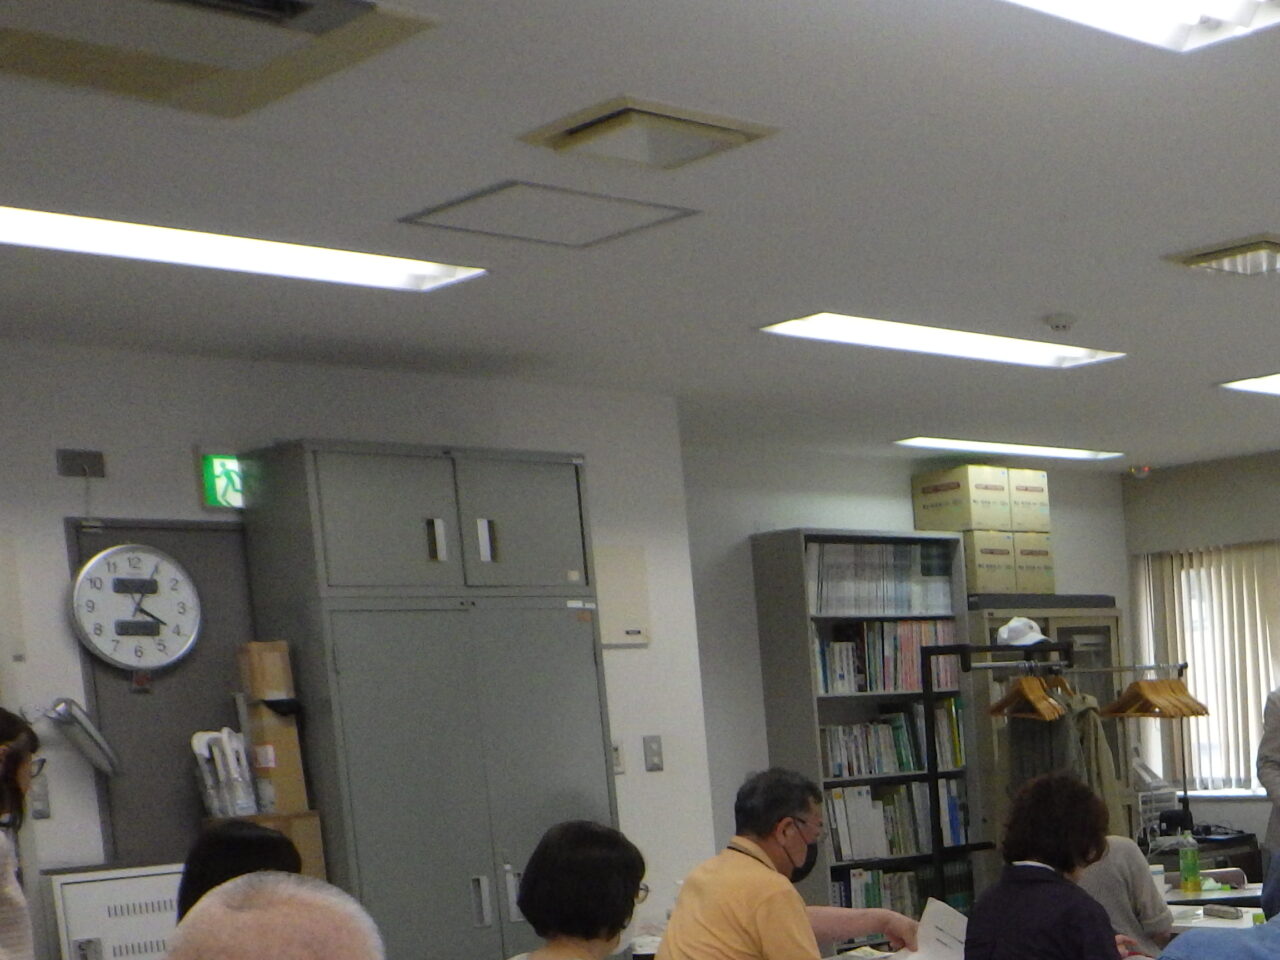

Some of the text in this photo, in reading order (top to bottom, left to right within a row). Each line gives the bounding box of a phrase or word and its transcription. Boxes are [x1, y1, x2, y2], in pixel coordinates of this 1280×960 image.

[106, 561, 118, 574] 11
[127, 556, 142, 569] 12
[88, 577, 103, 591] 10
[170, 578, 179, 592] 2
[86, 600, 95, 613] 9
[178, 601, 186, 615] 3
[93, 622, 103, 636] 8
[172, 624, 181, 637] 4
[111, 639, 120, 652] 7
[134, 645, 144, 658] 6
[157, 639, 167, 653] 5
